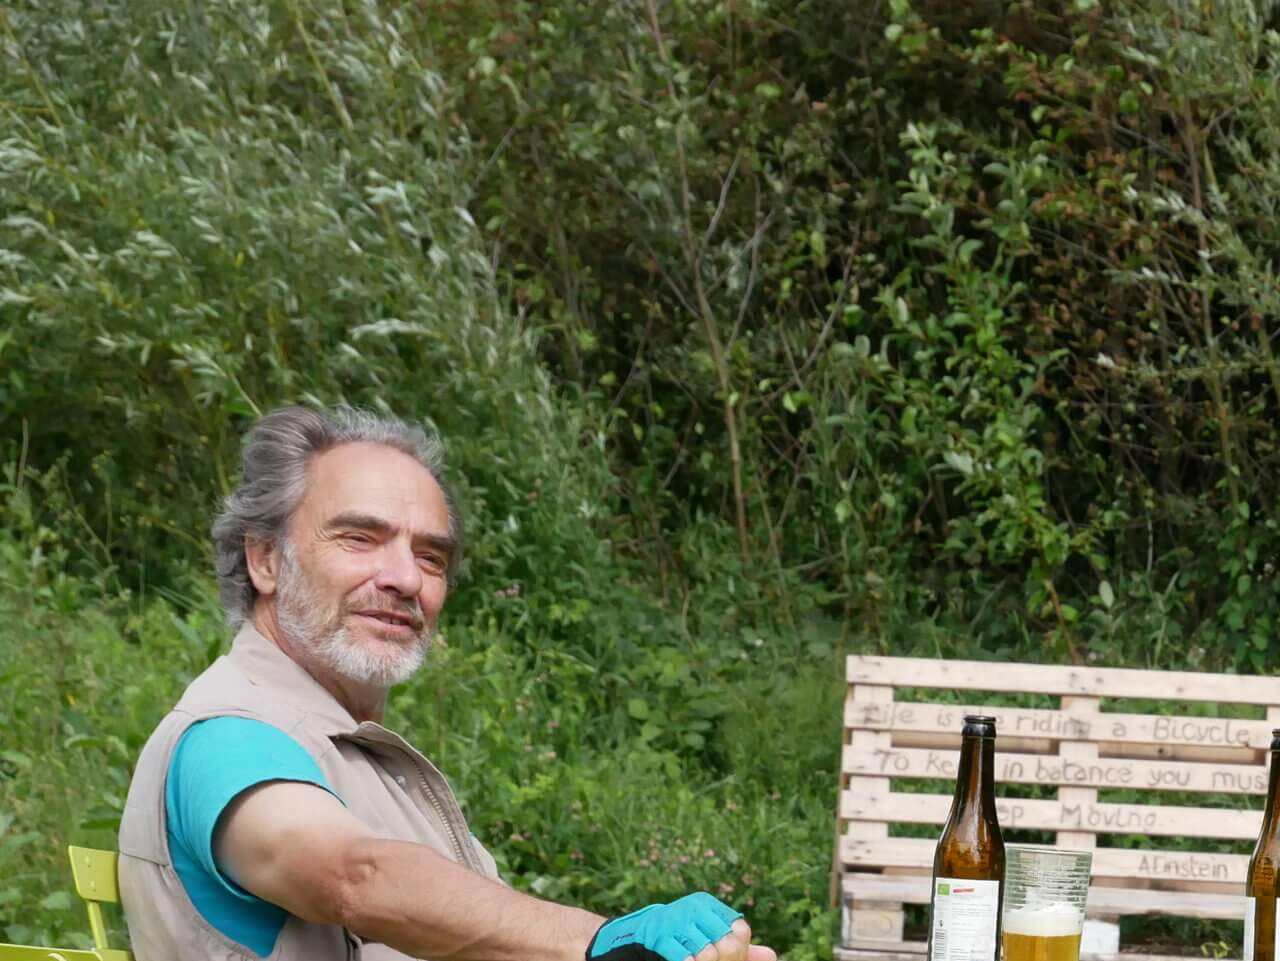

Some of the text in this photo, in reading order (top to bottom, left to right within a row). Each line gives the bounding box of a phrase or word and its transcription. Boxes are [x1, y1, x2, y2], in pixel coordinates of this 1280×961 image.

[937, 708, 953, 727] is
[1112, 724, 1127, 738] a
[874, 749, 910, 772] To
[1002, 759, 1024, 778] in
[1147, 767, 1191, 787] you
